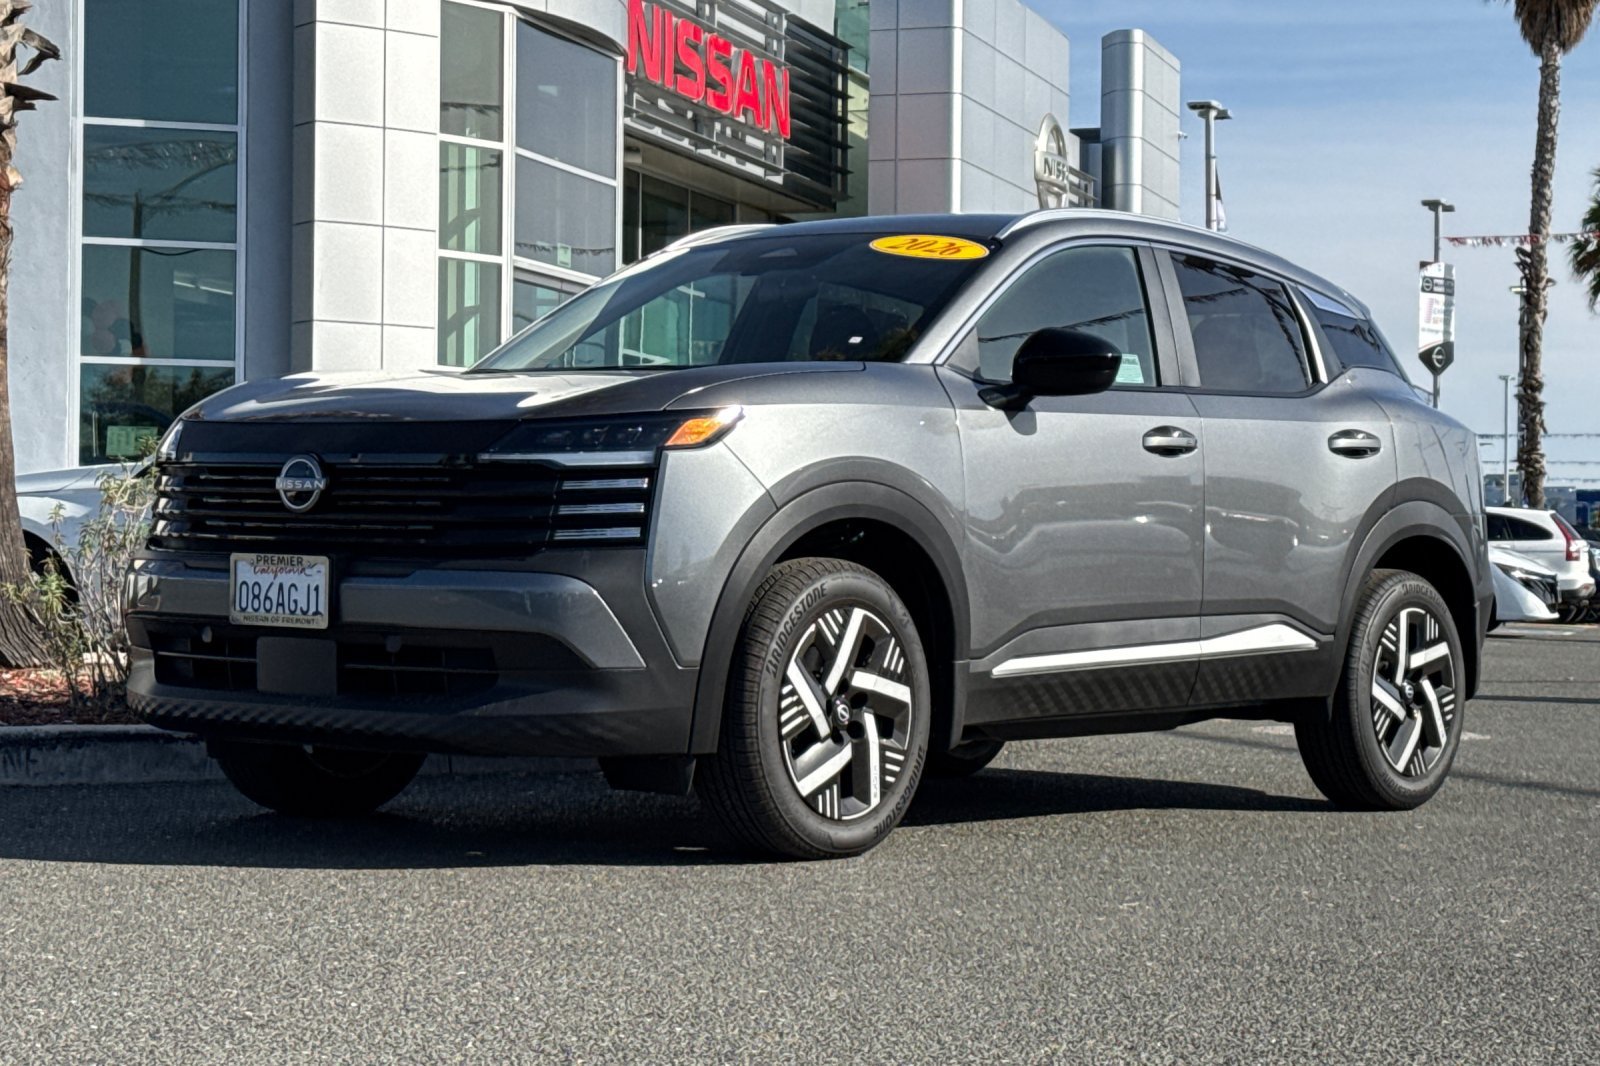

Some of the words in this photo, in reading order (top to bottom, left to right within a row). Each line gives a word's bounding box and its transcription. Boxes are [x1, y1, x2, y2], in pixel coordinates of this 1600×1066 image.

[626, 0, 791, 139] NISSAN
[885, 238, 963, 256] 2026
[276, 478, 325, 489] NISSAN
[256, 555, 304, 567] PREMIER
[239, 580, 322, 616] 086AGJ1
[243, 615, 269, 623] NISSAN
[281, 617, 315, 625] FREMONT
[765, 582, 829, 679] BRIDGESTONE
[873, 745, 925, 839] BRIDGESTONE
